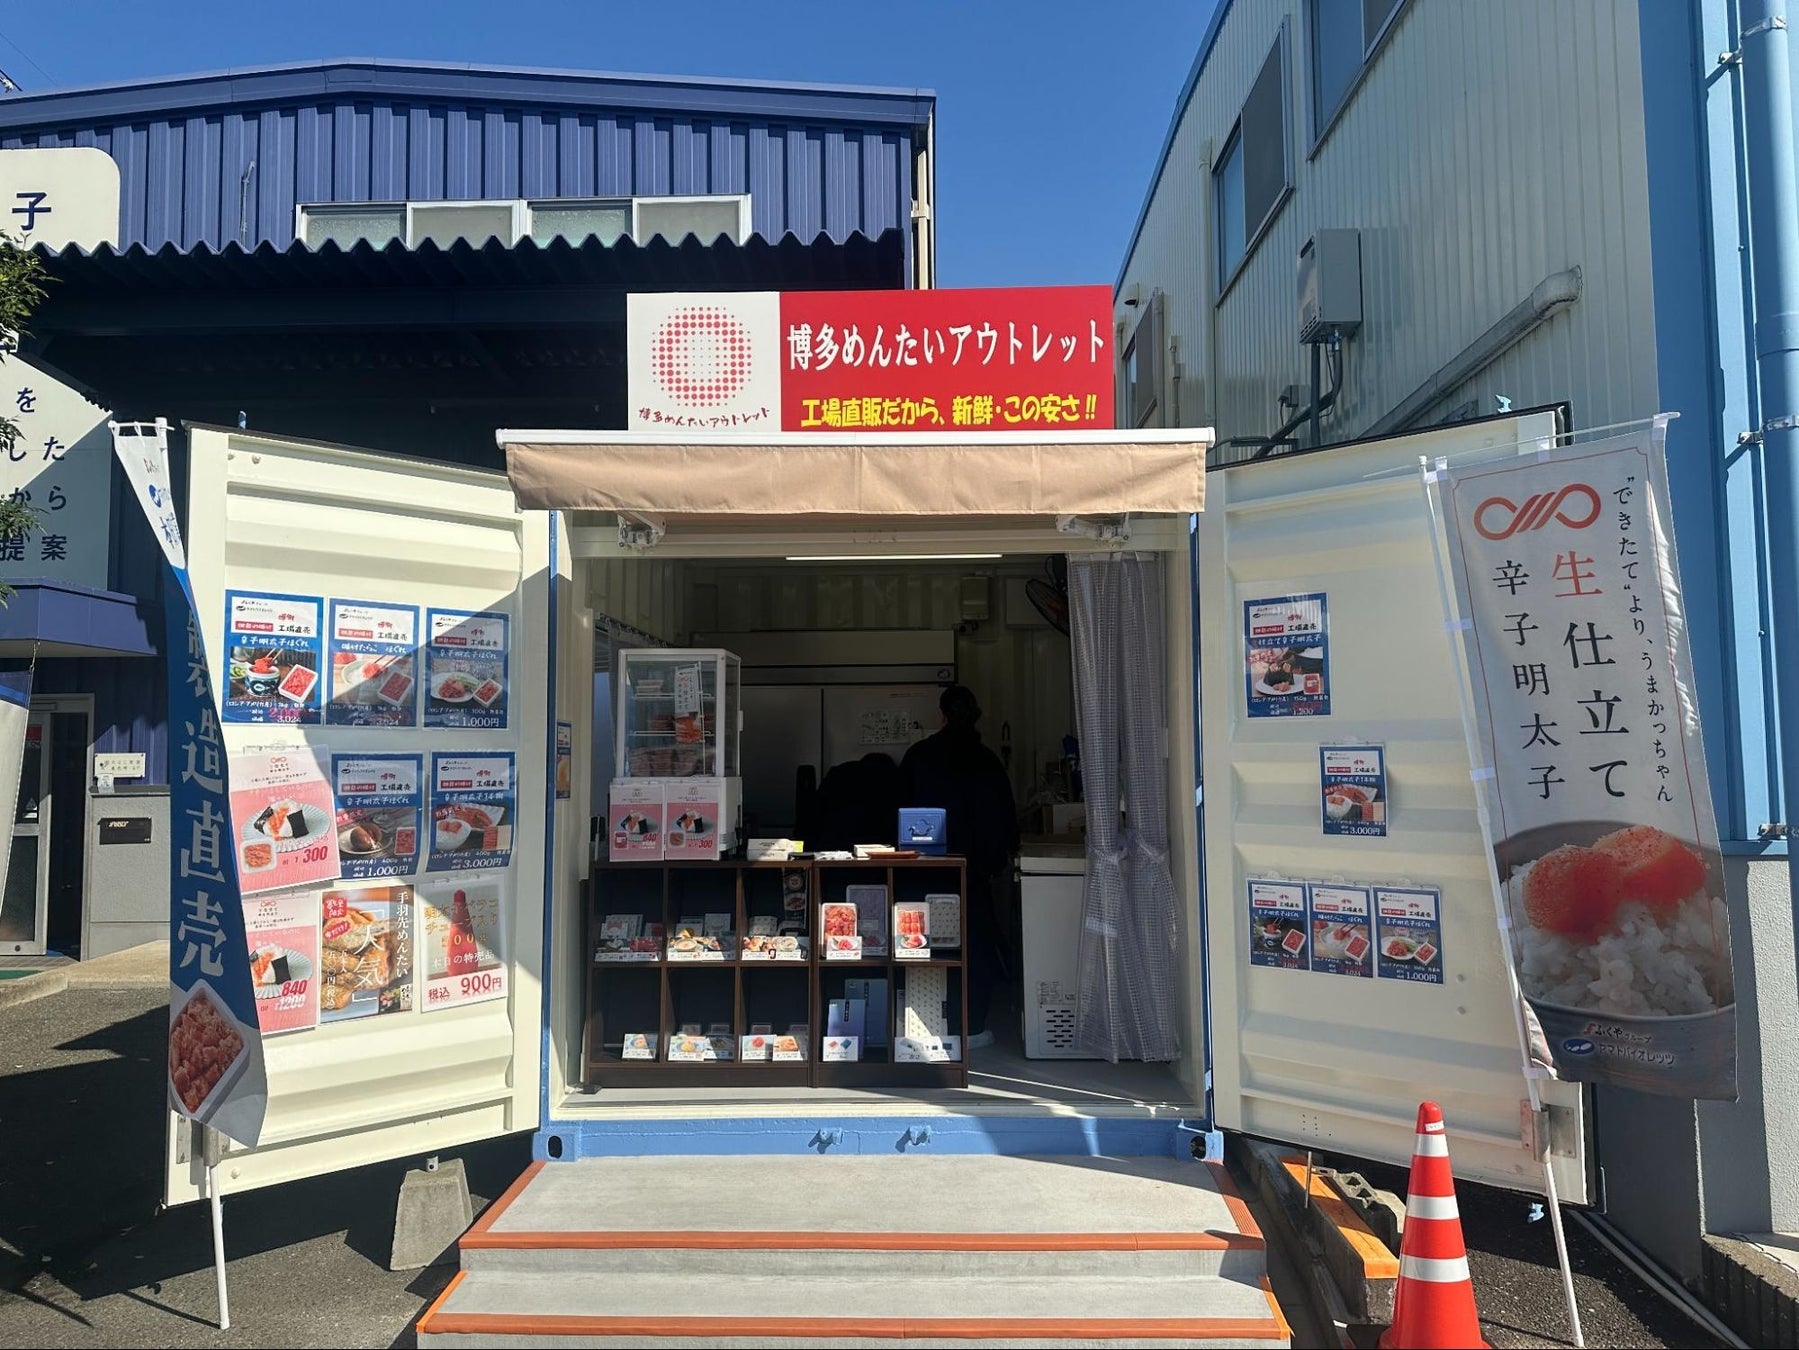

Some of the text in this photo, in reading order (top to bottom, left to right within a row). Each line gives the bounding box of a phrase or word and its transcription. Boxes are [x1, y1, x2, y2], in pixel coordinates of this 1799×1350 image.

[11, 191, 52, 231] 子
[787, 319, 1104, 371] 博多めんたいアウトレット
[16, 387, 36, 413] を
[639, 407, 770, 428] 博多めんたいアウトレット
[1493, 559, 1565, 800] 辛子明太子
[1552, 550, 1630, 798] 生仕立て
[396, 891, 409, 978] 手羽先めんたい
[281, 980, 308, 997] 840
[428, 987, 451, 1000] 税込
[460, 973, 502, 995] 900円
